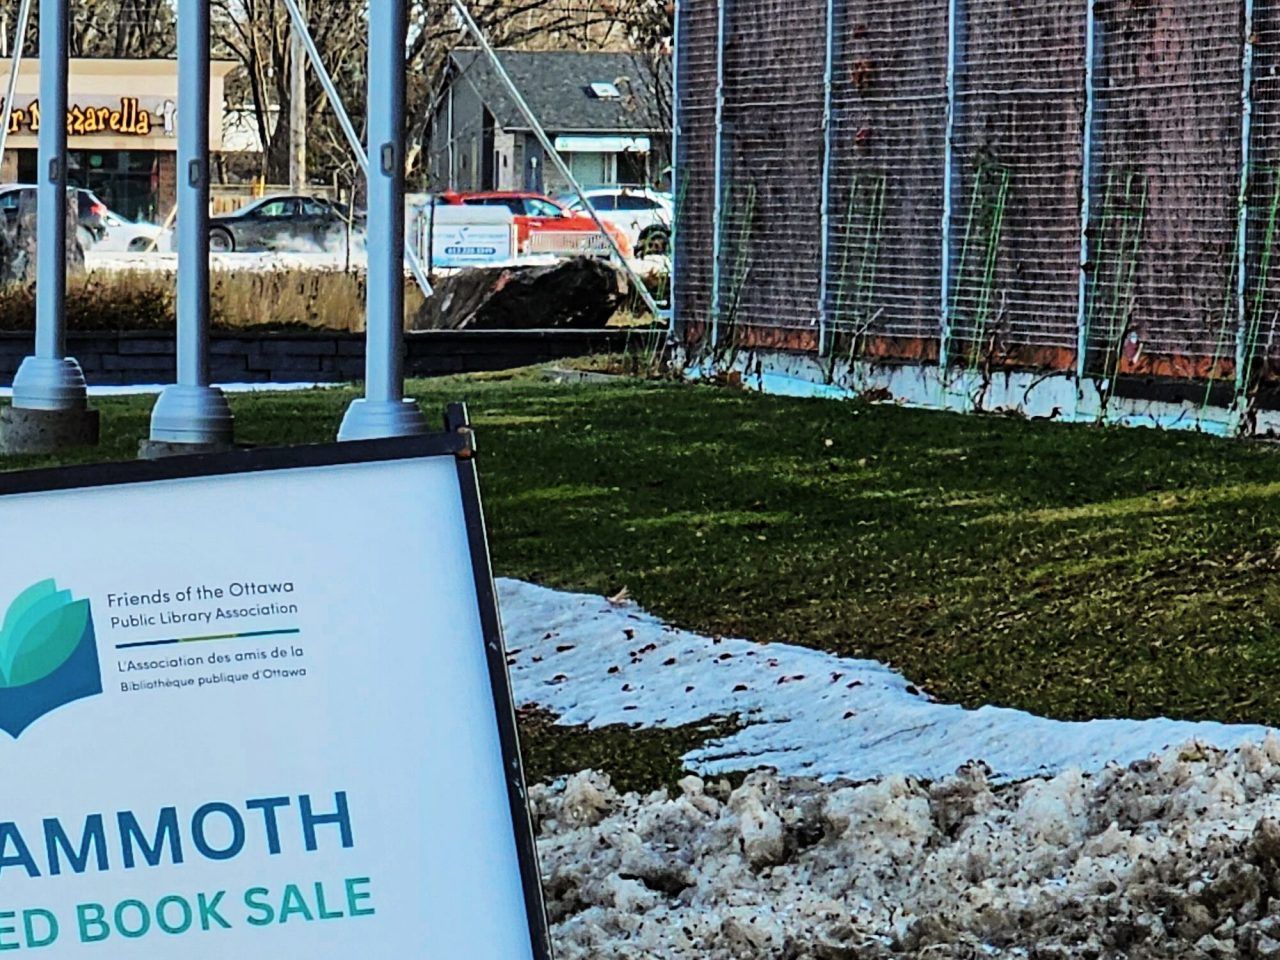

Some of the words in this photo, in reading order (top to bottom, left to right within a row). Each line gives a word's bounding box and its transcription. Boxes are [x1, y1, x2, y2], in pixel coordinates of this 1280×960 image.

[29, 97, 150, 135] Mzzarella
[107, 589, 171, 608] Friends
[175, 586, 192, 602] of
[196, 585, 224, 600] the
[229, 581, 295, 597] Ottawa
[110, 613, 156, 628] Public
[160, 610, 212, 625] Library
[216, 602, 298, 620] Association
[118, 656, 204, 673] L'Association
[207, 651, 231, 664] des
[235, 649, 267, 662] amis
[271, 647, 287, 659] de
[291, 646, 304, 657] la
[198, 672, 249, 687] publique
[252, 667, 306, 680] d'Ottawa
[77, 890, 233, 943] BOOK
[244, 877, 376, 927] SALE
